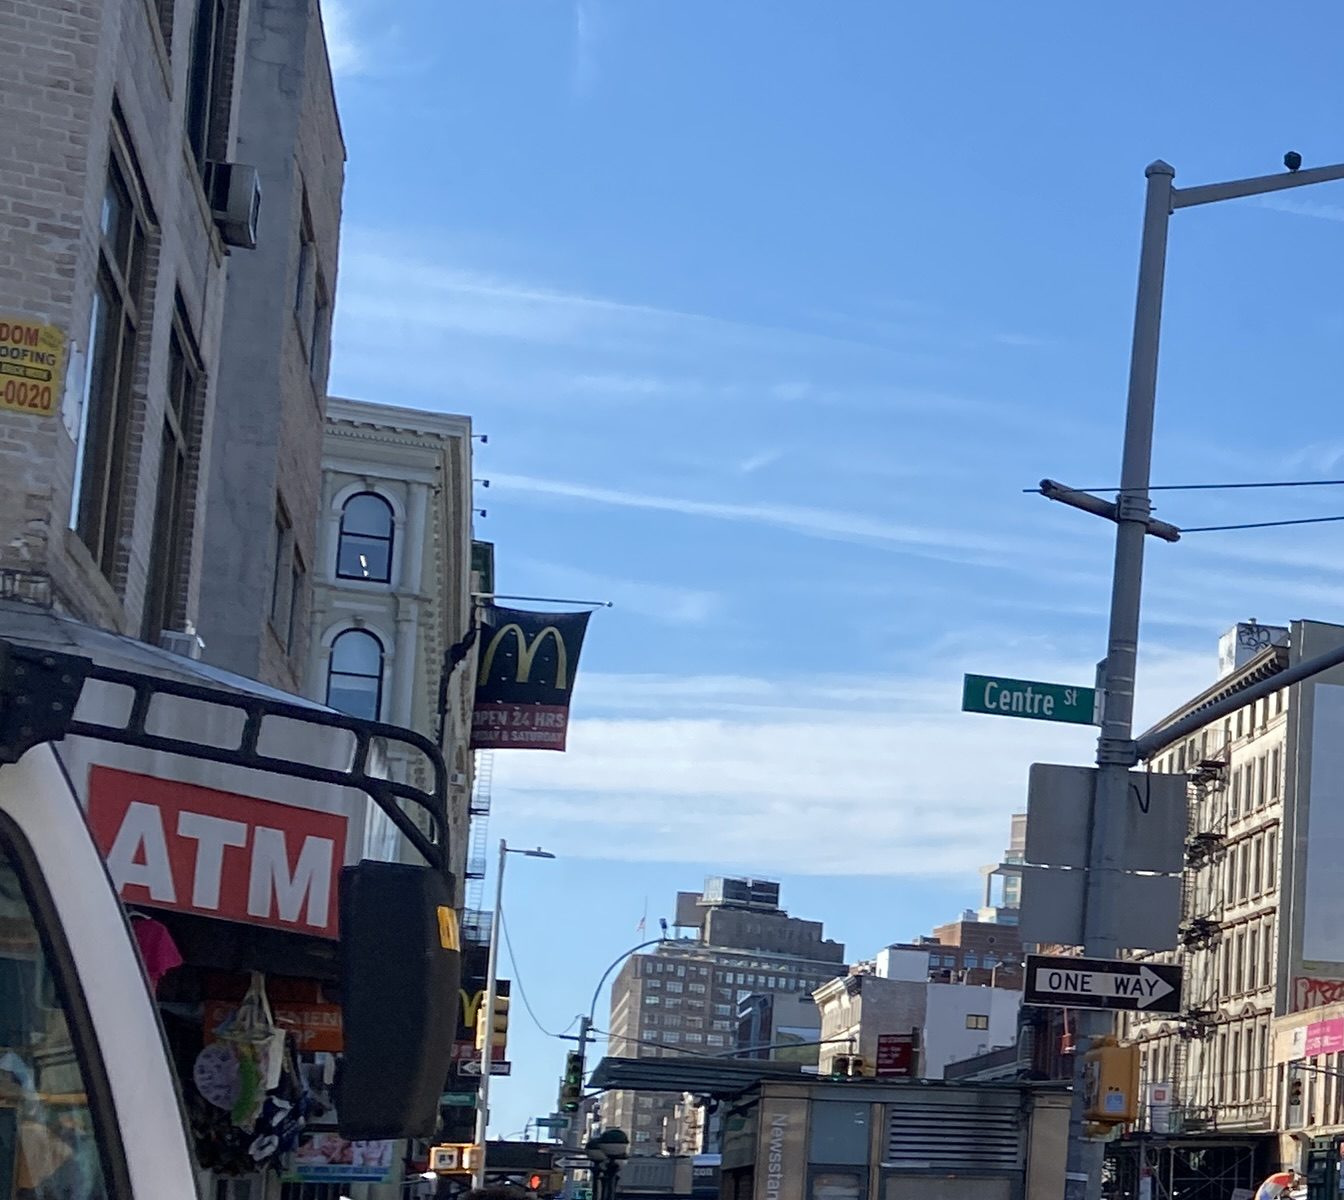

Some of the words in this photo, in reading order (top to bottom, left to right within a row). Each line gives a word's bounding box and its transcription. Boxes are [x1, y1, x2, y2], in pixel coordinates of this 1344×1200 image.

[983, 681, 1055, 715] Centre
[1064, 688, 1077, 706] St
[512, 712, 529, 726] 24
[535, 712, 565, 728] HRS
[511, 731, 563, 743] SATURDAY
[106, 800, 335, 928] ATM
[1049, 972, 1092, 992] ONE
[1114, 976, 1159, 997] WAY
